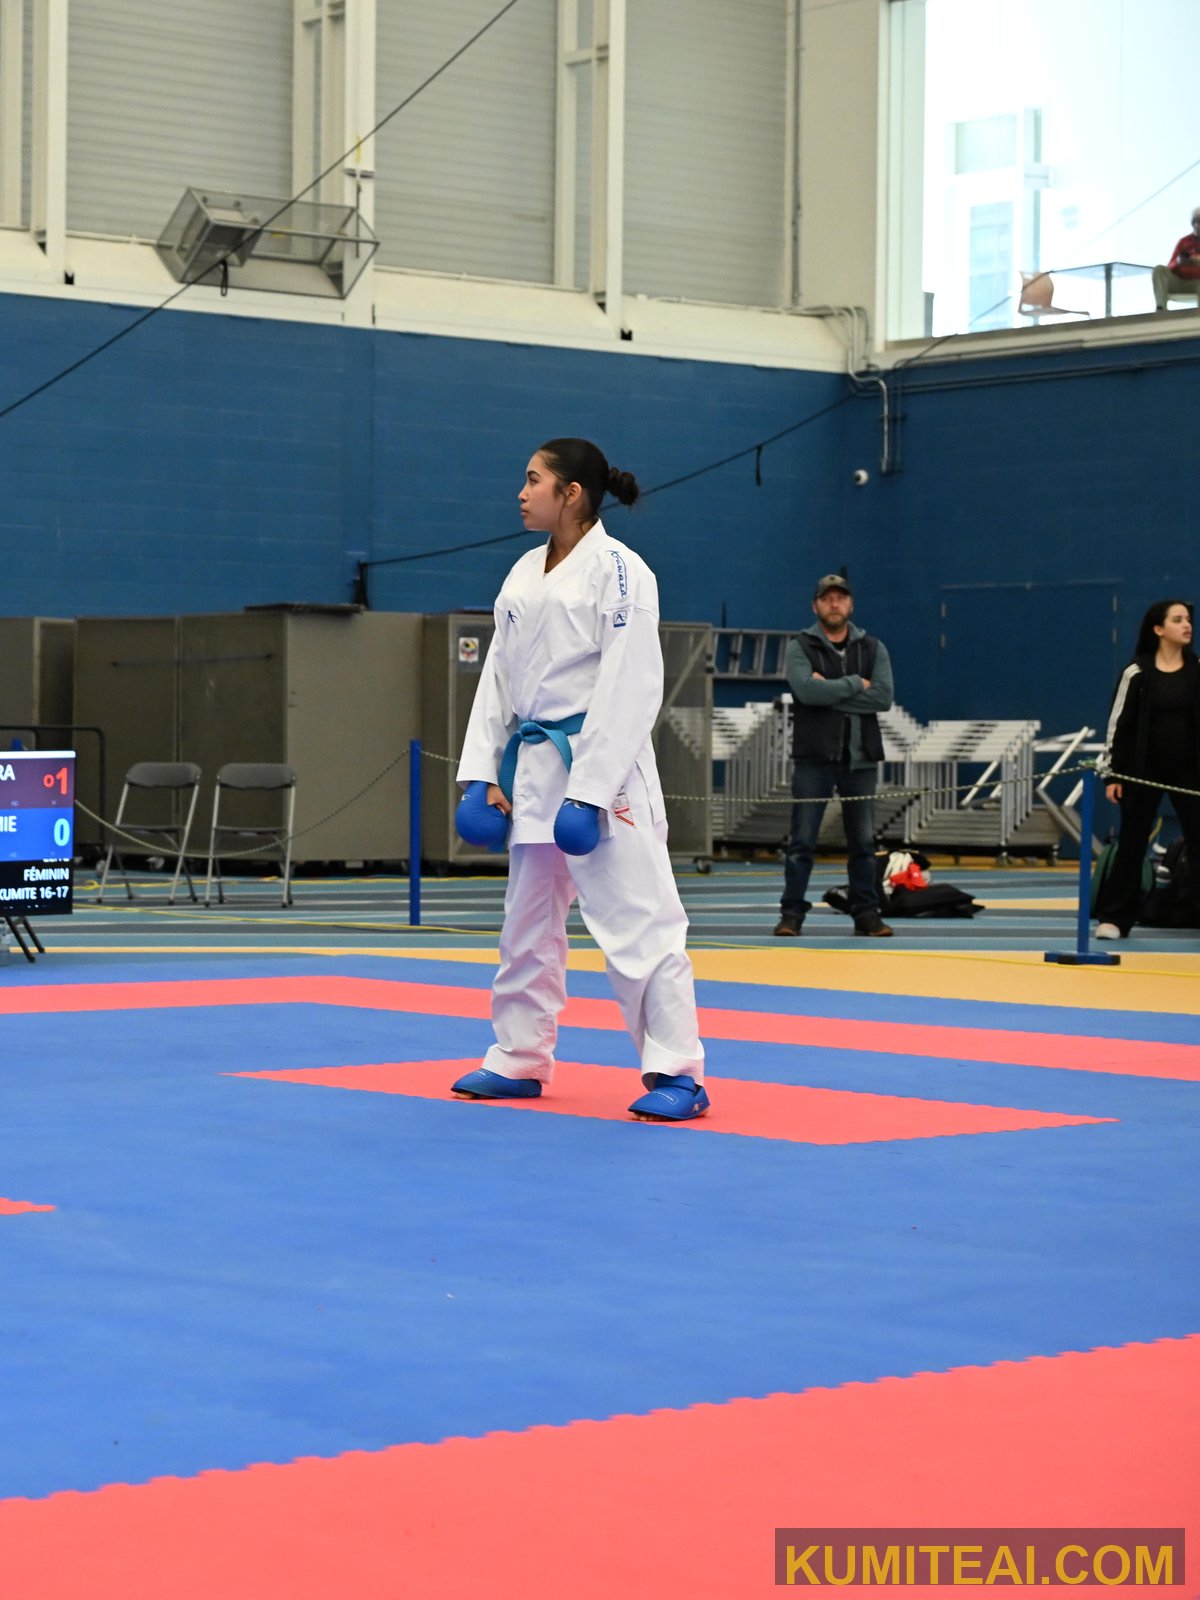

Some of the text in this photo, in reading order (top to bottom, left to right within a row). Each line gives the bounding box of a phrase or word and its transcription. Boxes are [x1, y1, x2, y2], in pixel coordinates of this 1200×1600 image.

[53, 817, 70, 846] 0
[23, 866, 70, 881] FÉMININ
[40, 886, 69, 899] 16-17
